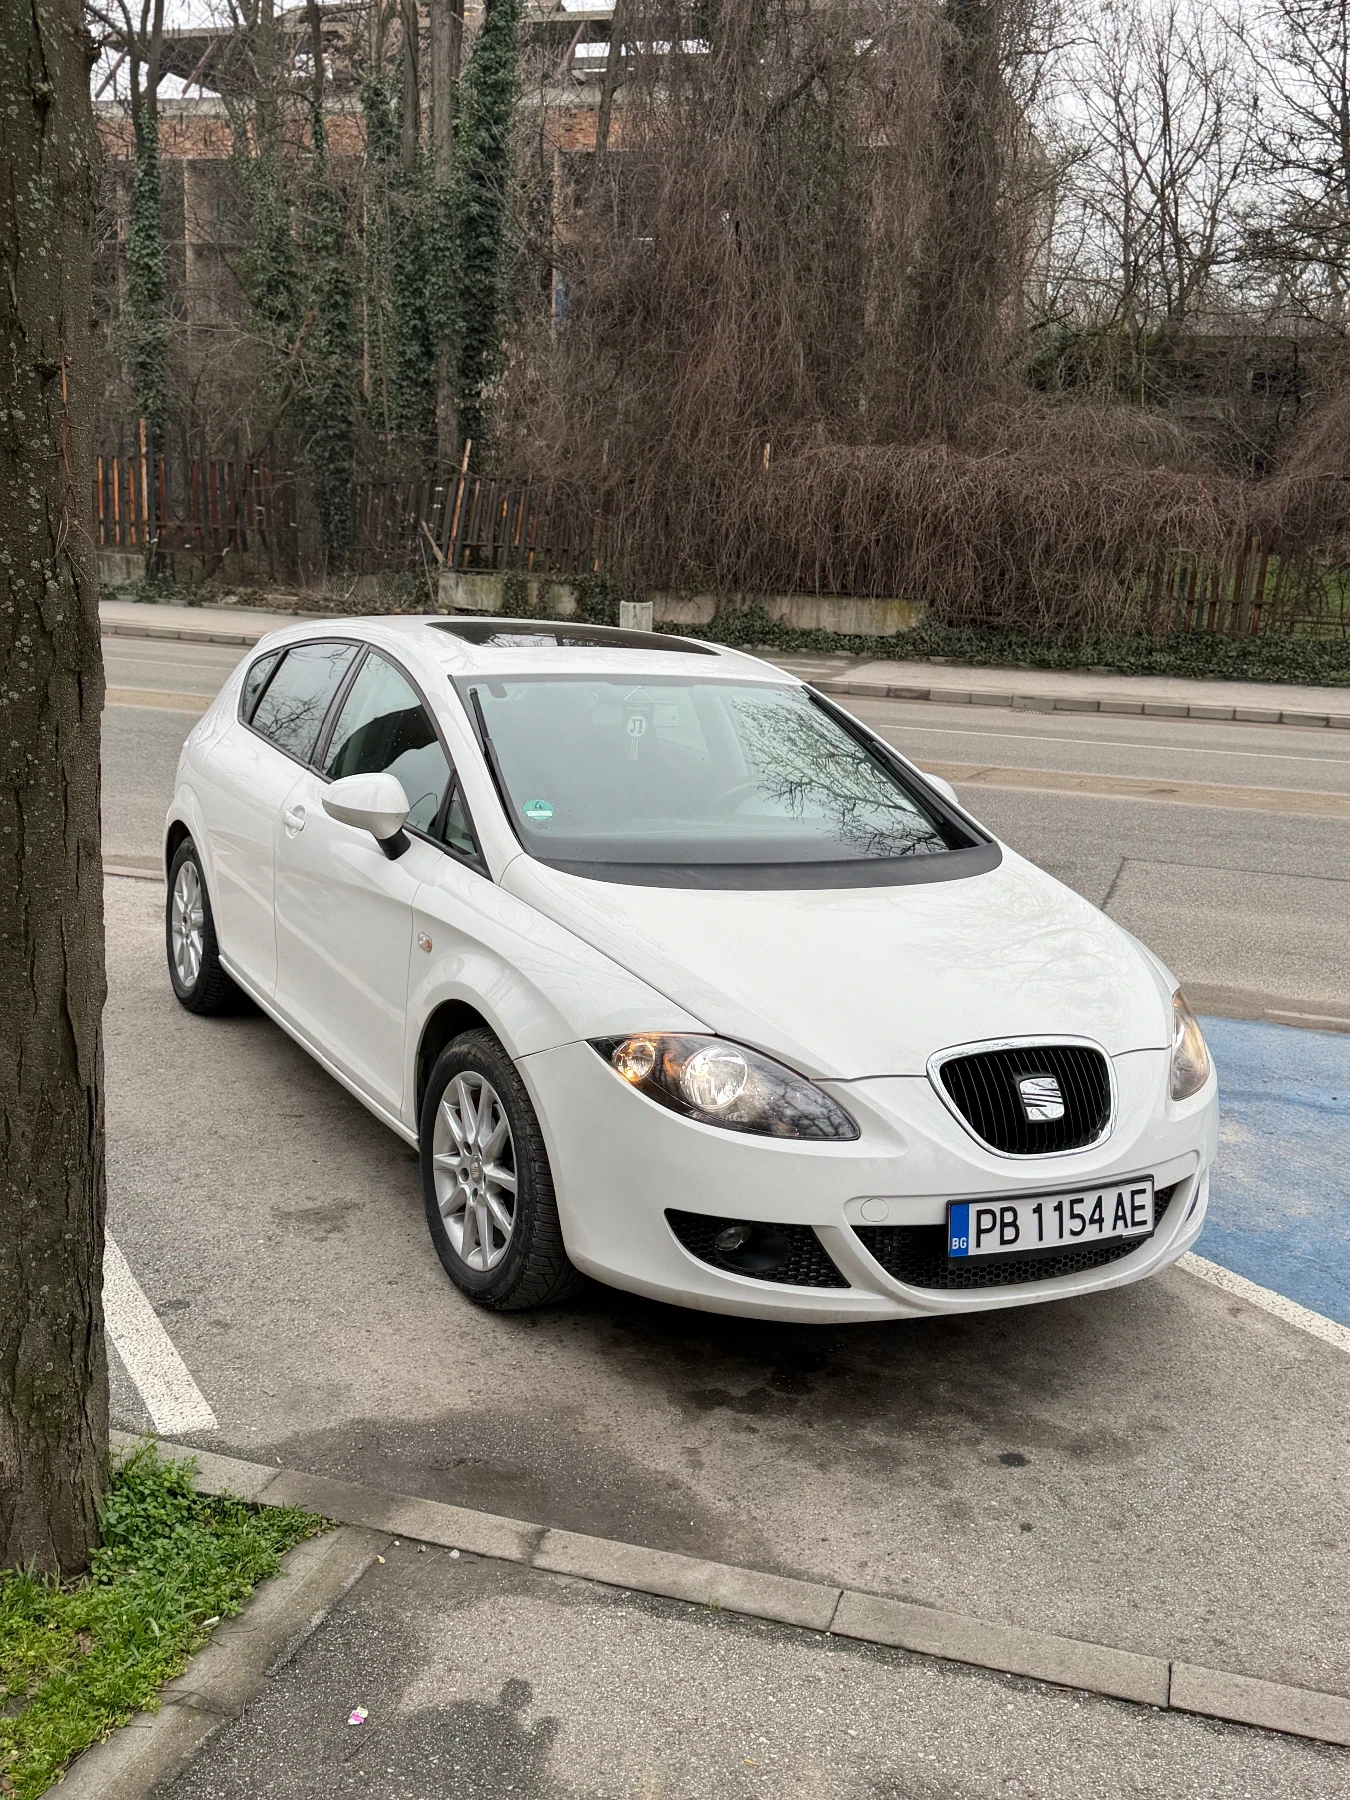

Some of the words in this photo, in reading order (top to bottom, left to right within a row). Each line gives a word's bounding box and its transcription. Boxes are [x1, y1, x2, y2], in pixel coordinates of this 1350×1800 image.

[534, 800, 543, 810] 4
[975, 1206, 1020, 1248] PB
[1032, 1195, 1105, 1241] 1154
[1112, 1188, 1147, 1230] AE
[951, 1236, 967, 1250] BG
